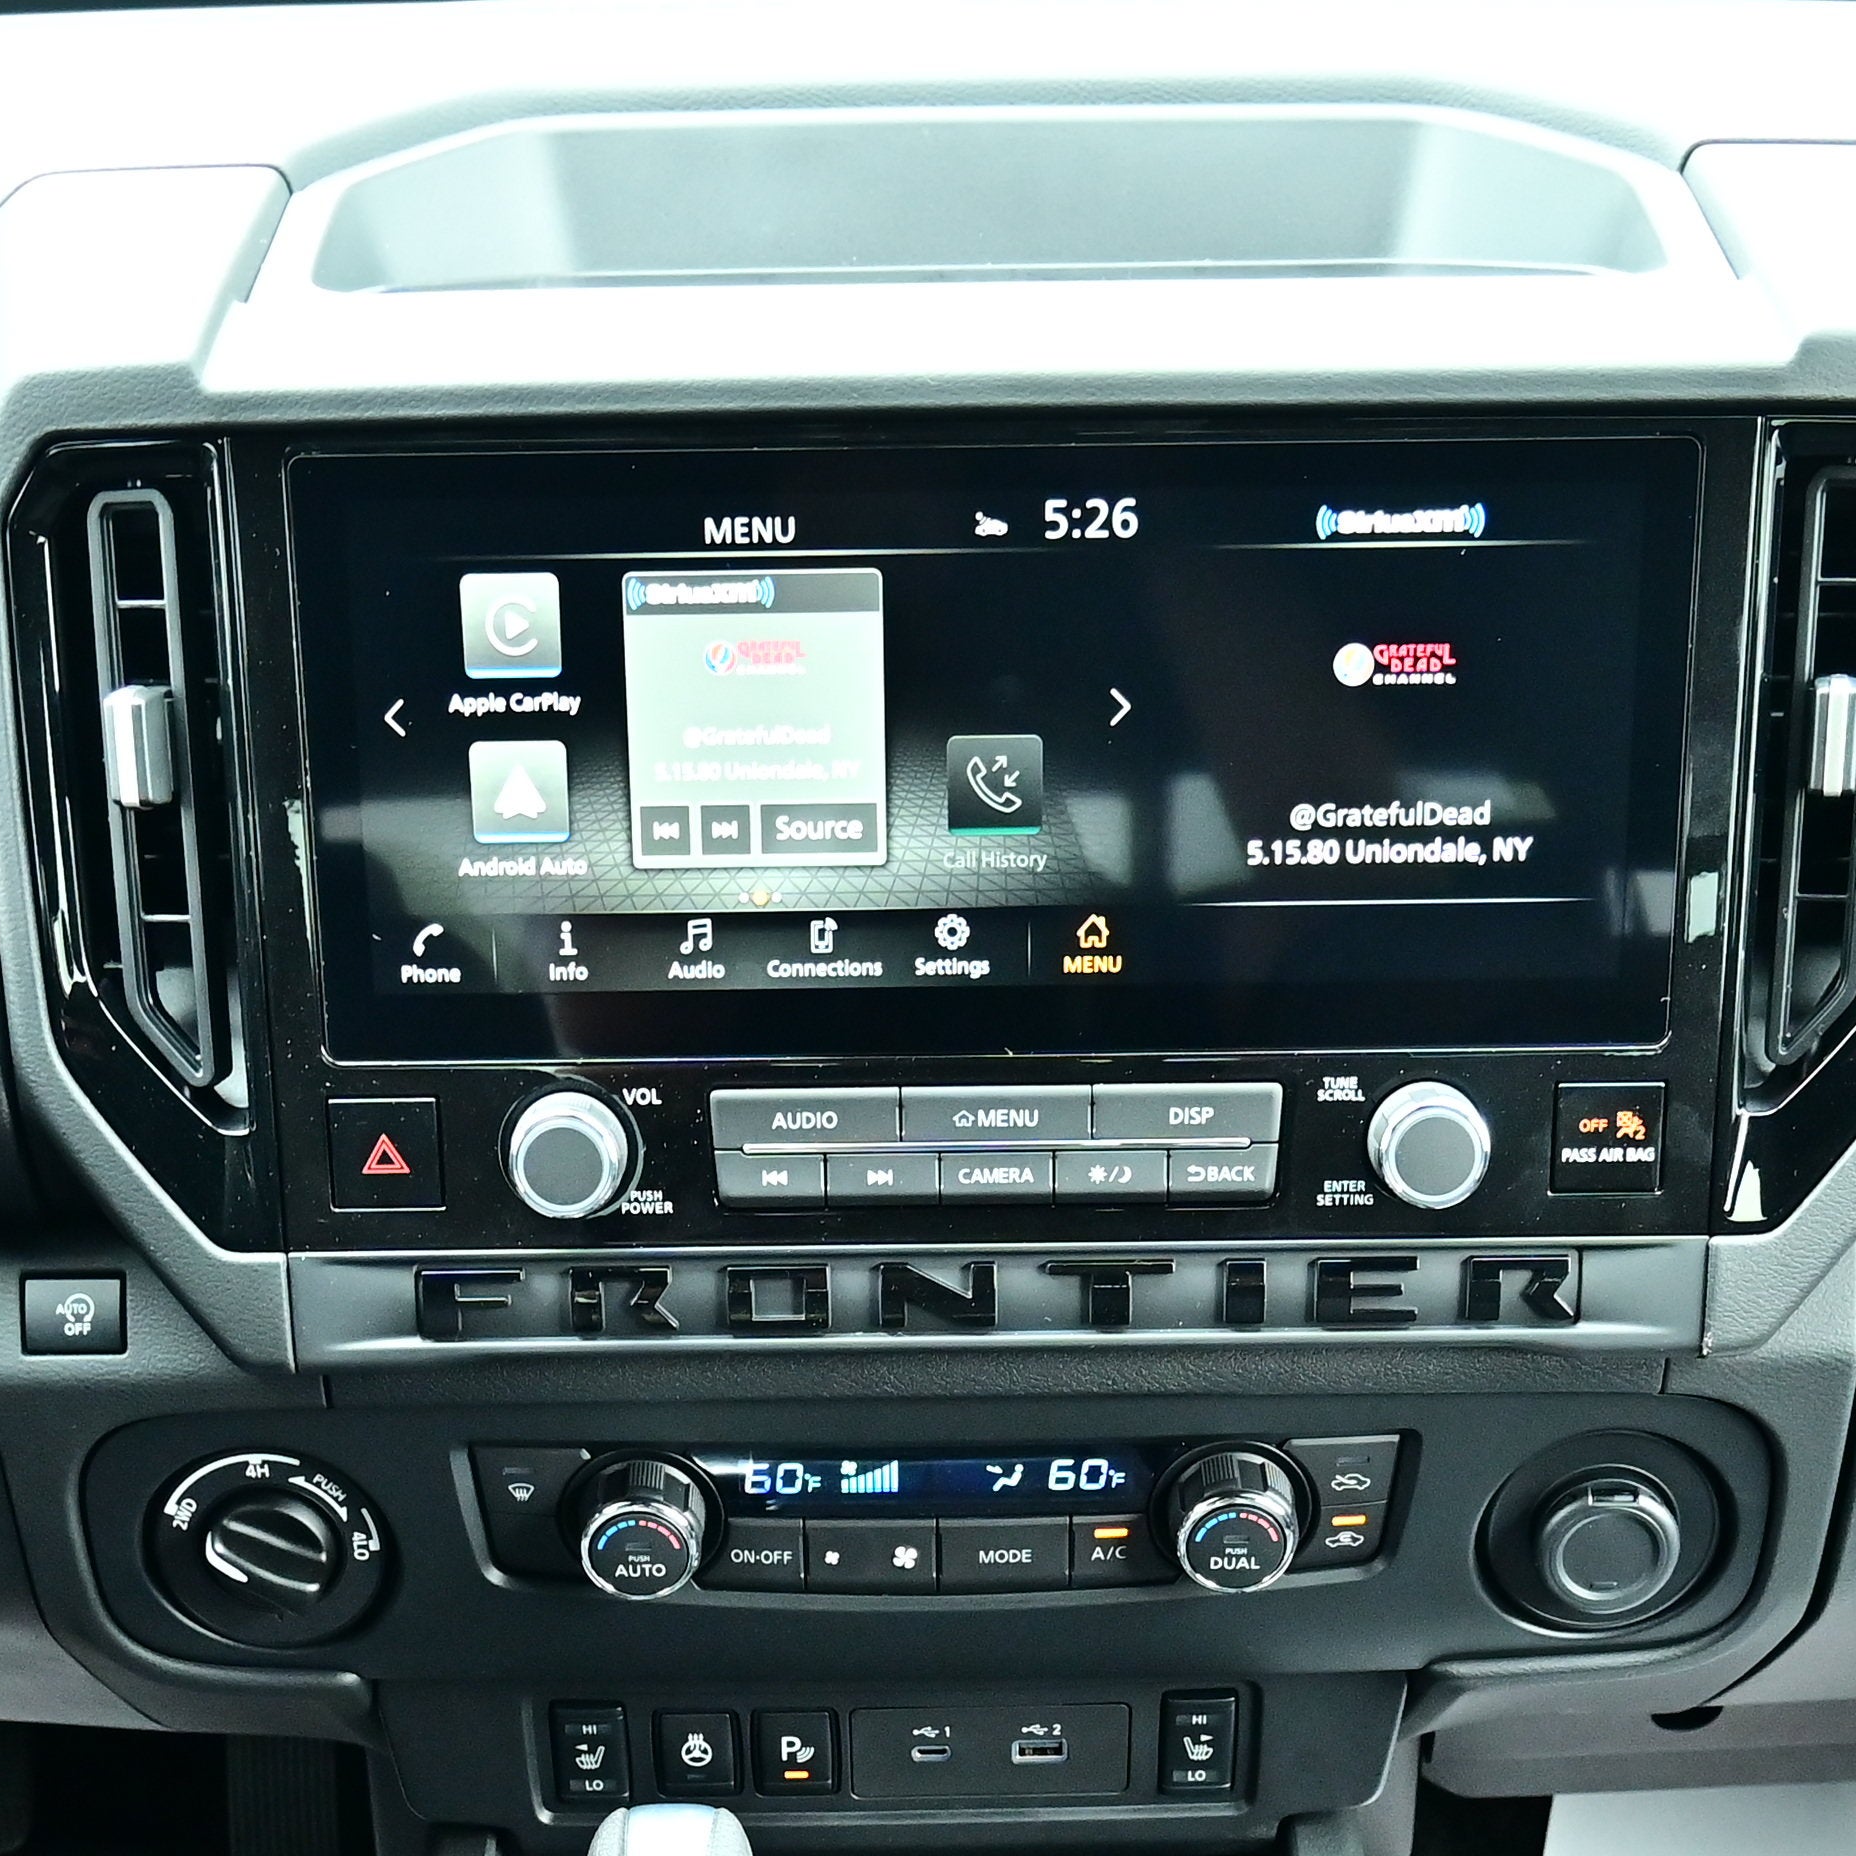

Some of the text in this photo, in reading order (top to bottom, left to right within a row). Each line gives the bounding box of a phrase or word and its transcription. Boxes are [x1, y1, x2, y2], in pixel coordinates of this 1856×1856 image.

[1043, 498, 1139, 539] 5:26
[704, 516, 796, 545] MENU
[1391, 657, 1442, 673] DEAD
[448, 692, 581, 716] Apple CarPlay
[1290, 801, 1491, 832] @GratefulDead
[775, 815, 863, 841] Source
[1246, 837, 1534, 867] 5.15.80 Uniondale, NY
[458, 855, 588, 877] Android Auto
[943, 850, 1048, 874] Call History
[400, 963, 461, 984] Phone
[549, 963, 589, 982] Info
[668, 960, 726, 980] Audio
[766, 958, 883, 979] Connections
[914, 956, 990, 979] Settings
[1063, 955, 1122, 975] MENU
[1323, 1076, 1359, 1090] TUNE
[622, 1087, 662, 1106] VOL
[1317, 1089, 1366, 1102] SCROLL
[772, 1109, 838, 1130] AUDIO
[977, 1108, 1039, 1128] MENU
[1169, 1107, 1215, 1126] DISP
[1578, 1117, 1609, 1134] OFF
[1561, 1146, 1655, 1162] PASS AIR BAG
[957, 1166, 1034, 1185] CAMERA
[1206, 1164, 1255, 1184] BACK
[629, 1190, 663, 1202] PUSH
[1324, 1180, 1366, 1193] ENTER
[621, 1201, 674, 1215] POWER
[1316, 1192, 1374, 1207] SETTING
[416, 1256, 1580, 1338] FRONTIER
[55, 1302, 87, 1317] AUTO
[63, 1322, 92, 1337] OFF
[246, 1464, 271, 1480] 4H
[311, 1473, 348, 1504] PUSH
[172, 1497, 199, 1531] 2WD
[350, 1530, 370, 1562] 4LO
[1091, 1544, 1128, 1562] A/C
[978, 1547, 1033, 1565] MODE
[1209, 1555, 1261, 1571] DUAL
[615, 1562, 667, 1579] AUTO
[582, 1723, 598, 1735] HI
[1191, 1715, 1208, 1725] HI
[1187, 1770, 1207, 1781] LO
[585, 1779, 604, 1792] LO
